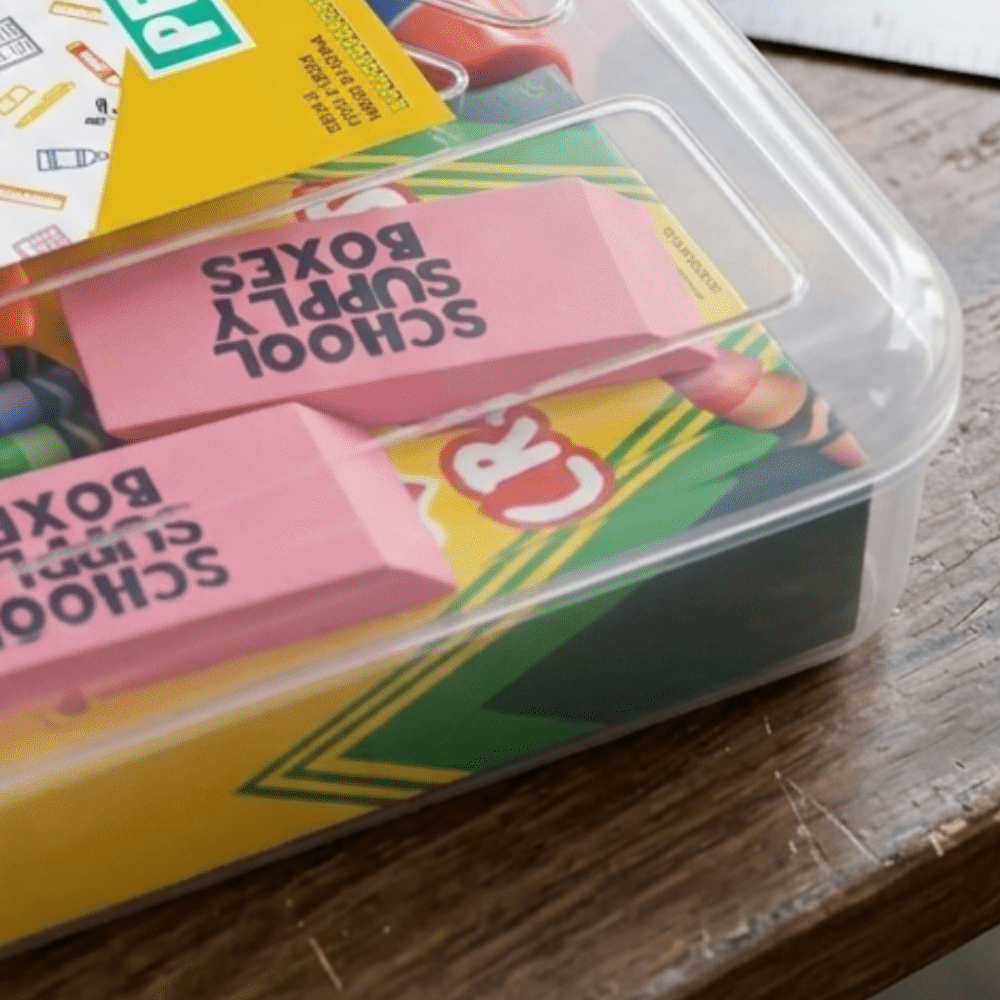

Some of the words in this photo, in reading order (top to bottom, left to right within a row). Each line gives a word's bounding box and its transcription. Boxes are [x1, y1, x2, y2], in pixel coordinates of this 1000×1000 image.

[201, 221, 426, 295] BOXES
[212, 258, 462, 342] SUPPLY
[213, 298, 488, 380] SCHOOL
[453, 406, 605, 524] CR
